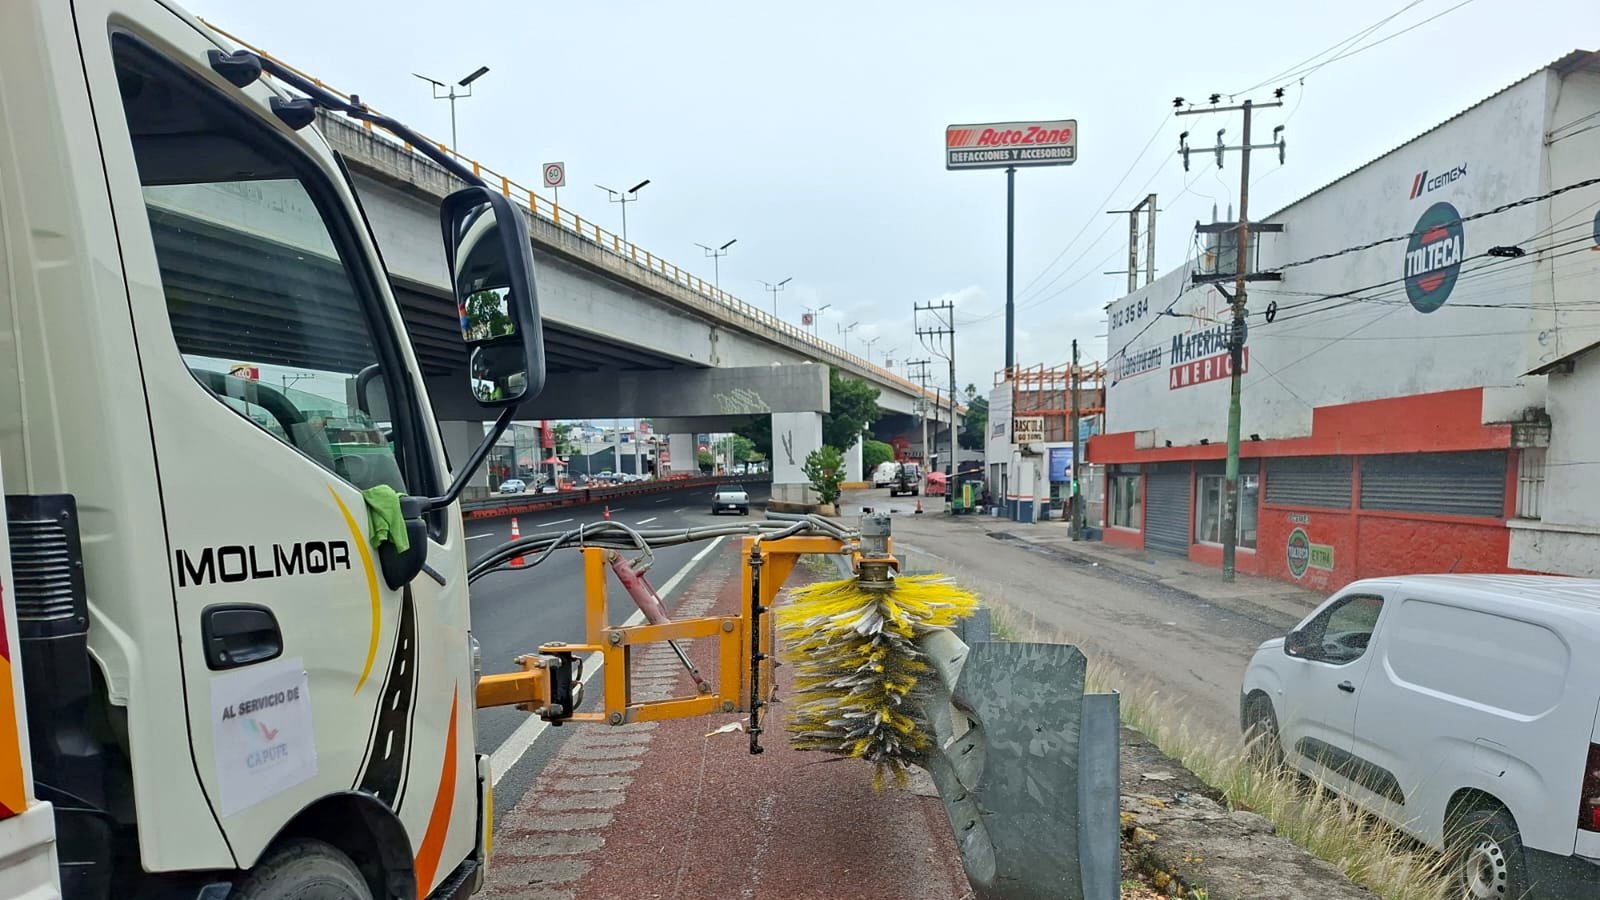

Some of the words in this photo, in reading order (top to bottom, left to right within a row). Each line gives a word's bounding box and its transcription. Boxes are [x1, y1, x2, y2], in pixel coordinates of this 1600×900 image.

[952, 150, 1009, 162] REFACCIONES
[1012, 150, 1018, 159] Y
[1020, 148, 1072, 159] ACCESORIOS
[549, 168, 558, 177] 60
[1406, 236, 1461, 276] TOLTECA
[1125, 304, 1135, 324] 35
[1137, 296, 1148, 319] 84
[175, 541, 351, 587] MOLMOR
[222, 705, 237, 721] AL
[238, 691, 285, 716] SERVICIO
[287, 686, 300, 702] DE
